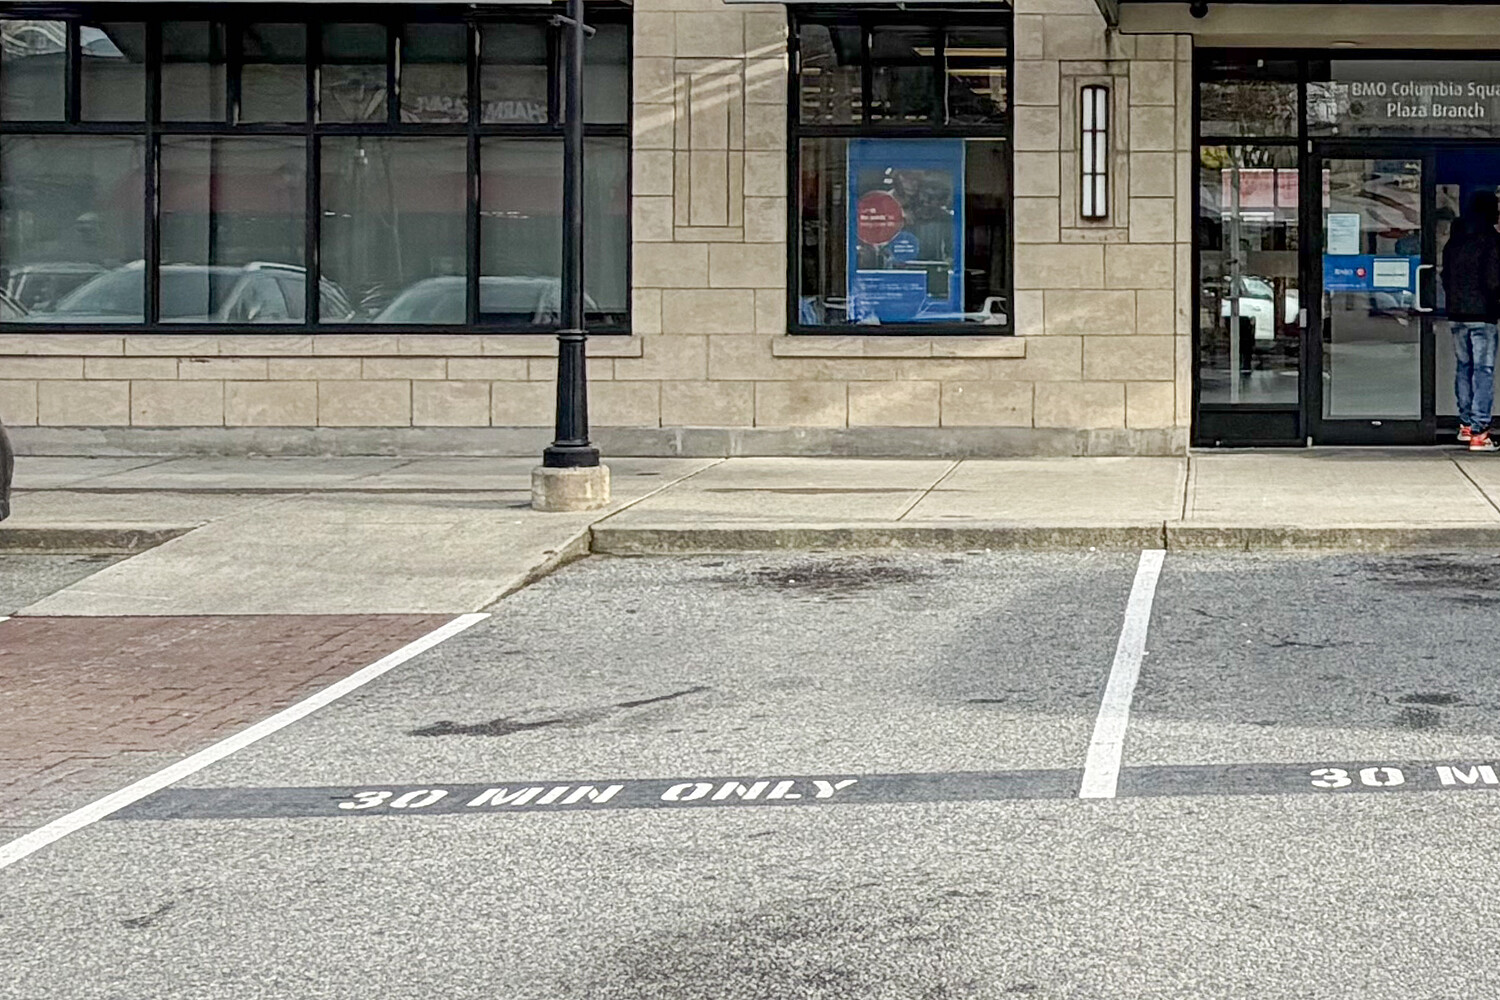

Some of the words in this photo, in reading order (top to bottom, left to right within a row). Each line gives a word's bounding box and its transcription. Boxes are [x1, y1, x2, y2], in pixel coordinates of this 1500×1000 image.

[1352, 82, 1387, 96] BMO
[1392, 81, 1463, 97] Columbia
[1387, 102, 1428, 118] Plaza
[1432, 102, 1485, 118] Branch
[1310, 767, 1405, 788] 30
[338, 789, 448, 810] 30
[466, 784, 625, 807] MIN
[660, 779, 859, 801] ONLY
